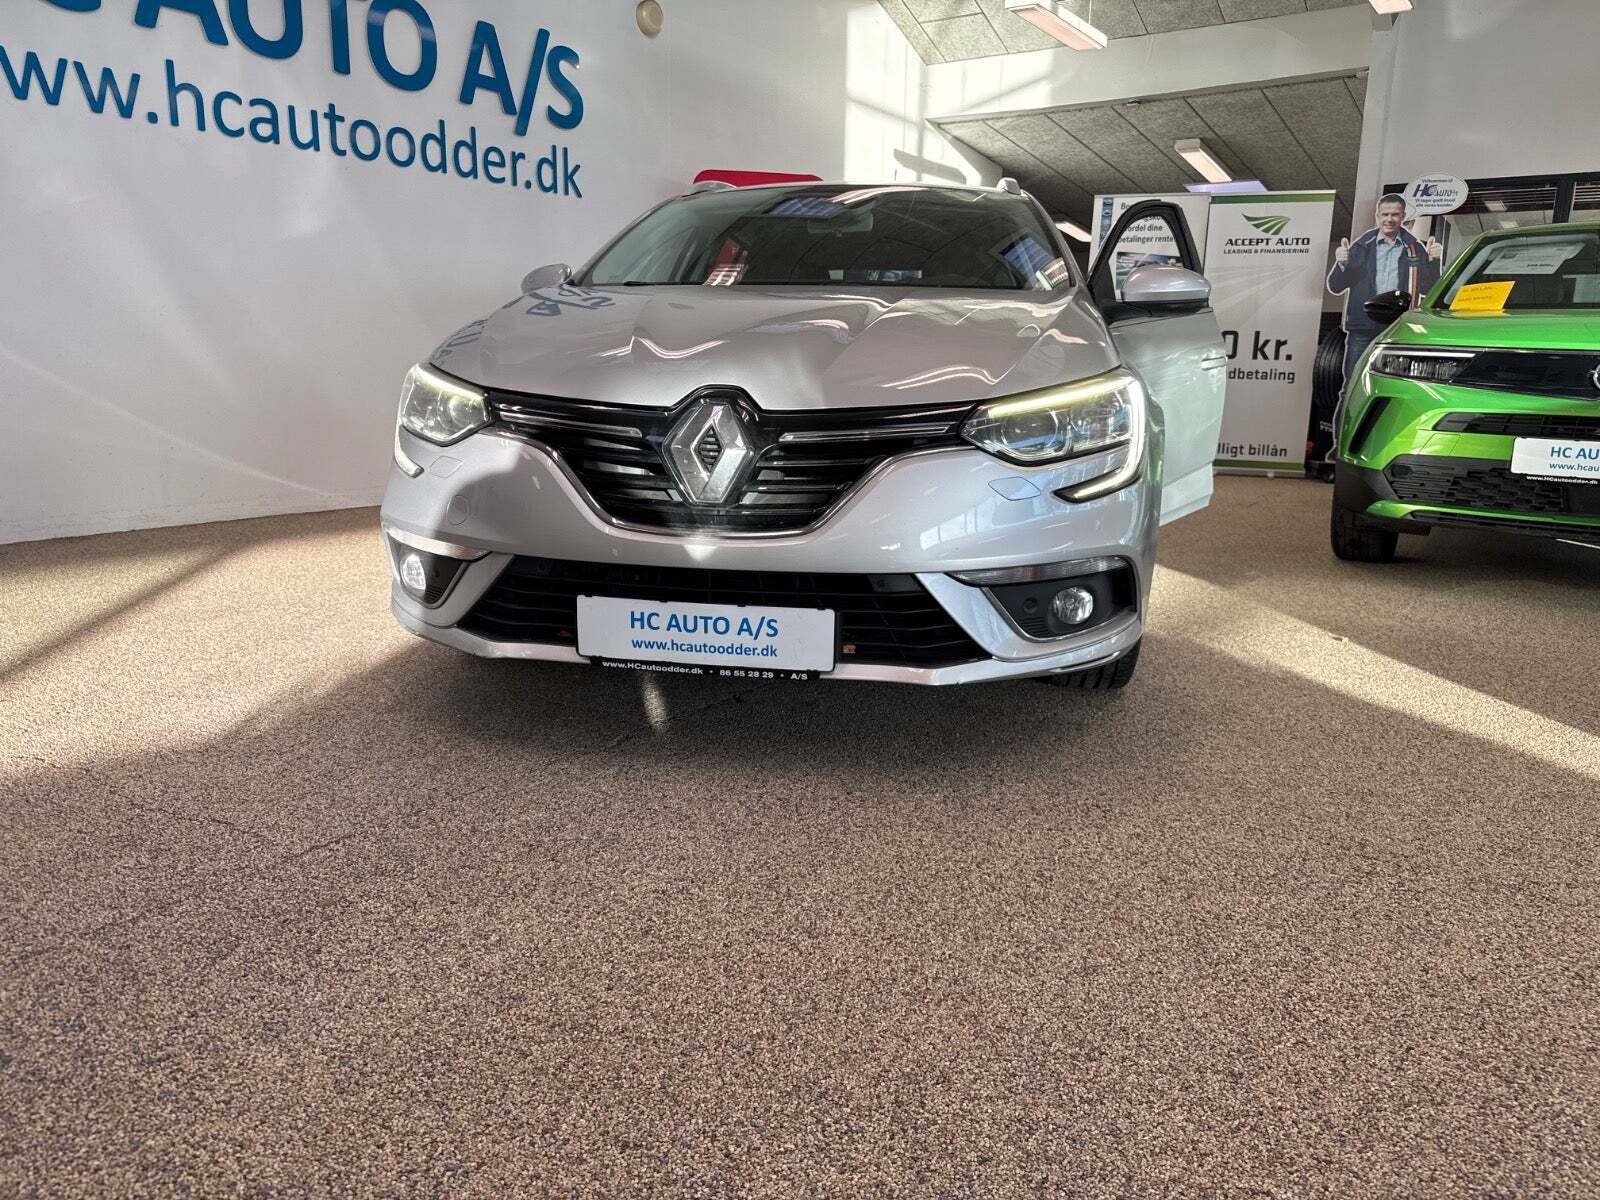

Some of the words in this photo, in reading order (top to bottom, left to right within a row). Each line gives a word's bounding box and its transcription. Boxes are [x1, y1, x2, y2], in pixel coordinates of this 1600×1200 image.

[459, 20, 584, 136] A/S
[1147, 224, 1163, 232] dine
[1225, 238, 1271, 246] ACCEPT
[1275, 237, 1310, 246] AUTO
[1252, 331, 1292, 360] kr.
[1228, 368, 1295, 384] dbetaling
[1248, 443, 1287, 457] billån
[1550, 446, 1572, 458] HC
[630, 610, 661, 631] HC
[666, 613, 731, 636] AUTO
[737, 615, 779, 640] A/S
[631, 638, 778, 657] www.hcautoodder.dk
[602, 660, 704, 675] www.HCautoodder.dk
[790, 672, 808, 680] A/S
